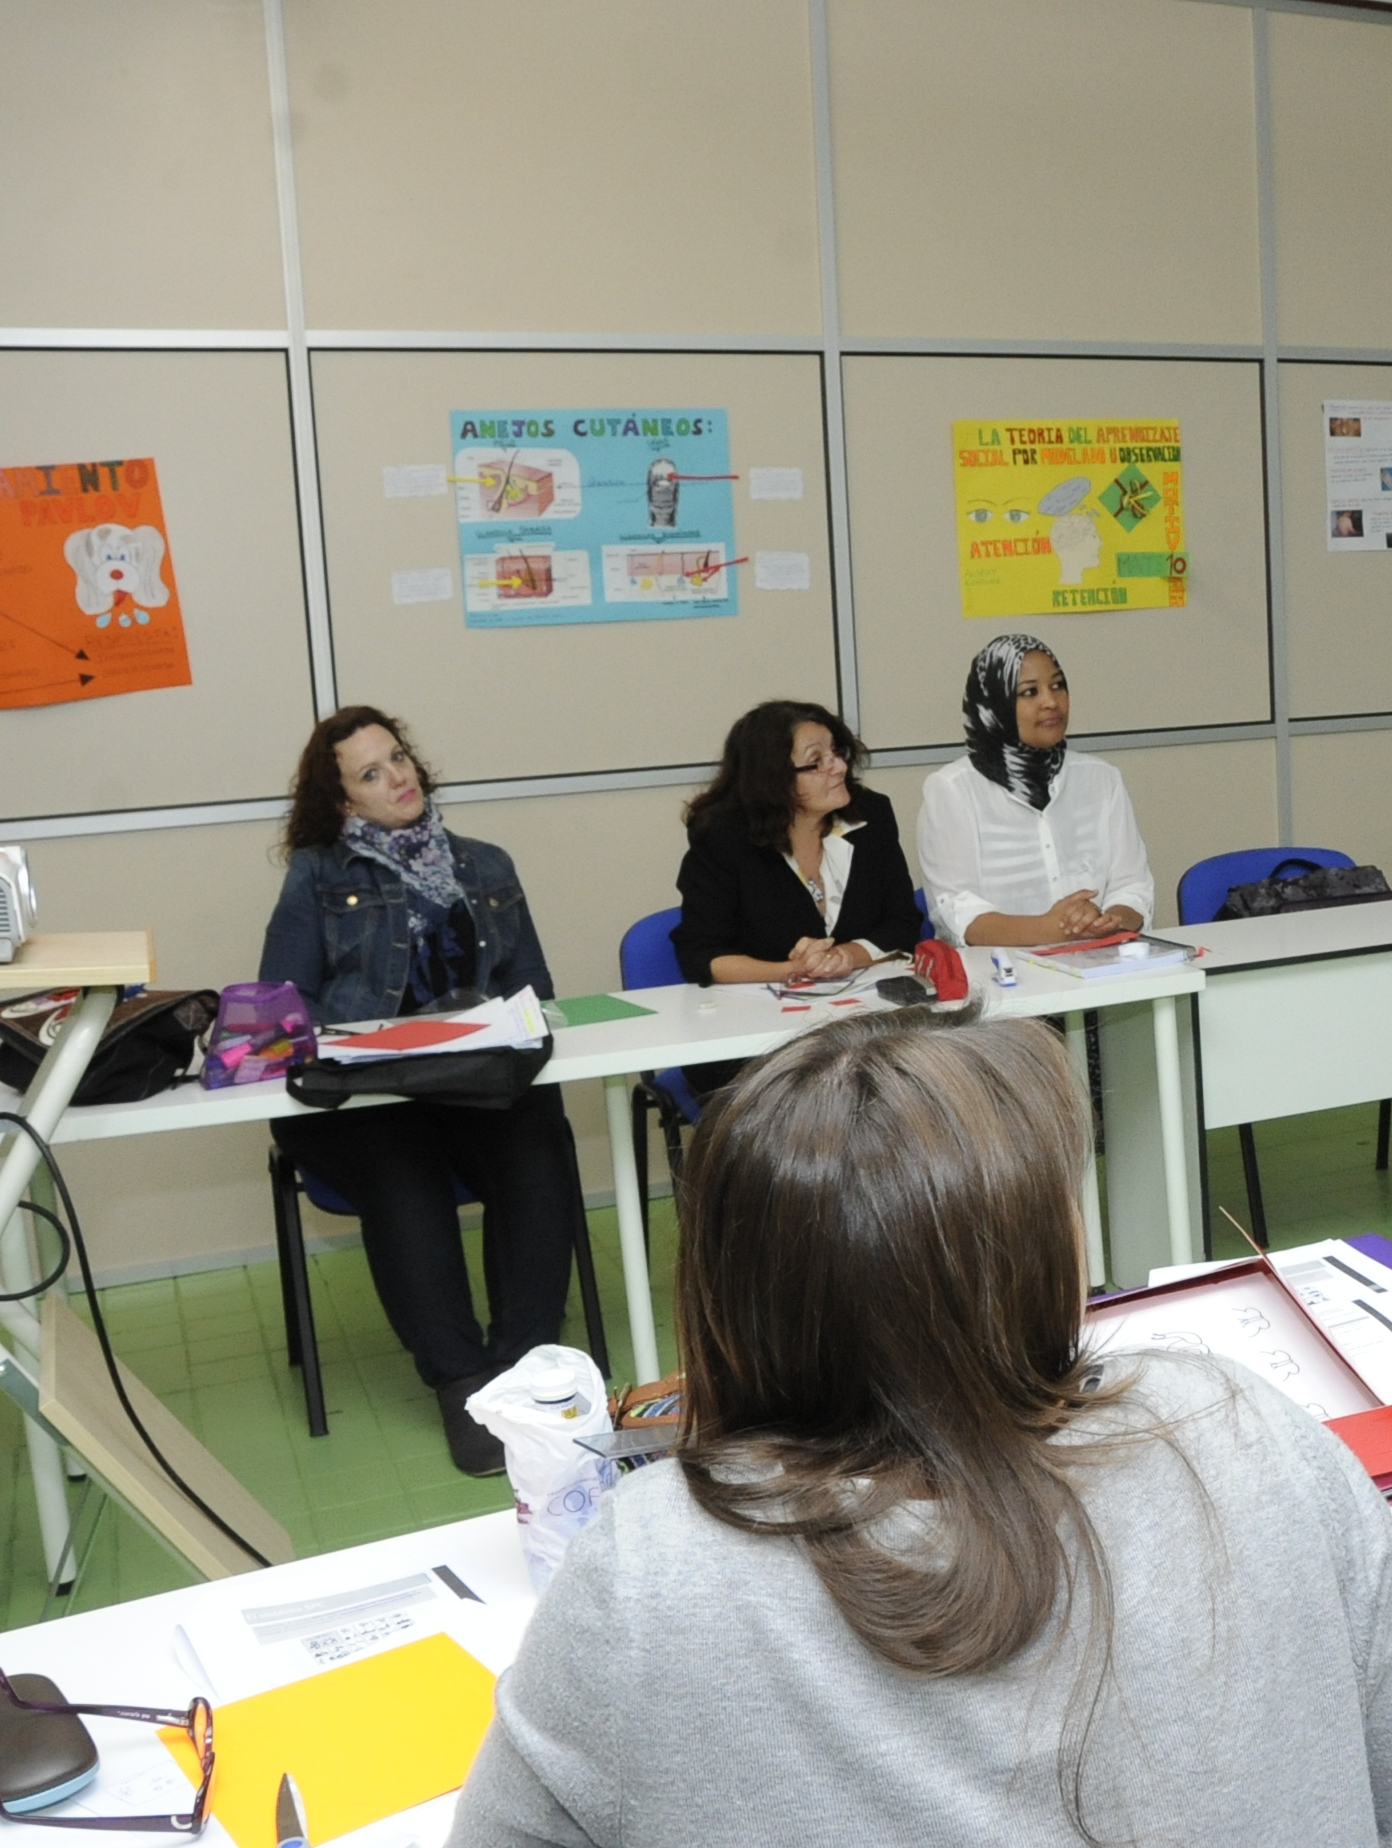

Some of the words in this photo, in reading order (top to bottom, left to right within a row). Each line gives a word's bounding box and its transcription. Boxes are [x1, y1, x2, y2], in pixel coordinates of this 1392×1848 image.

[460, 419, 555, 439] ANEJOS
[572, 412, 713, 438] CUTÁNEOS:
[977, 427, 1002, 446] LA
[1005, 427, 1064, 446] TEORIA
[1068, 426, 1092, 445] DEL
[958, 448, 1009, 467] SOCIAL
[1012, 447, 1038, 466] POR
[19, 492, 142, 527] PAVLOV
